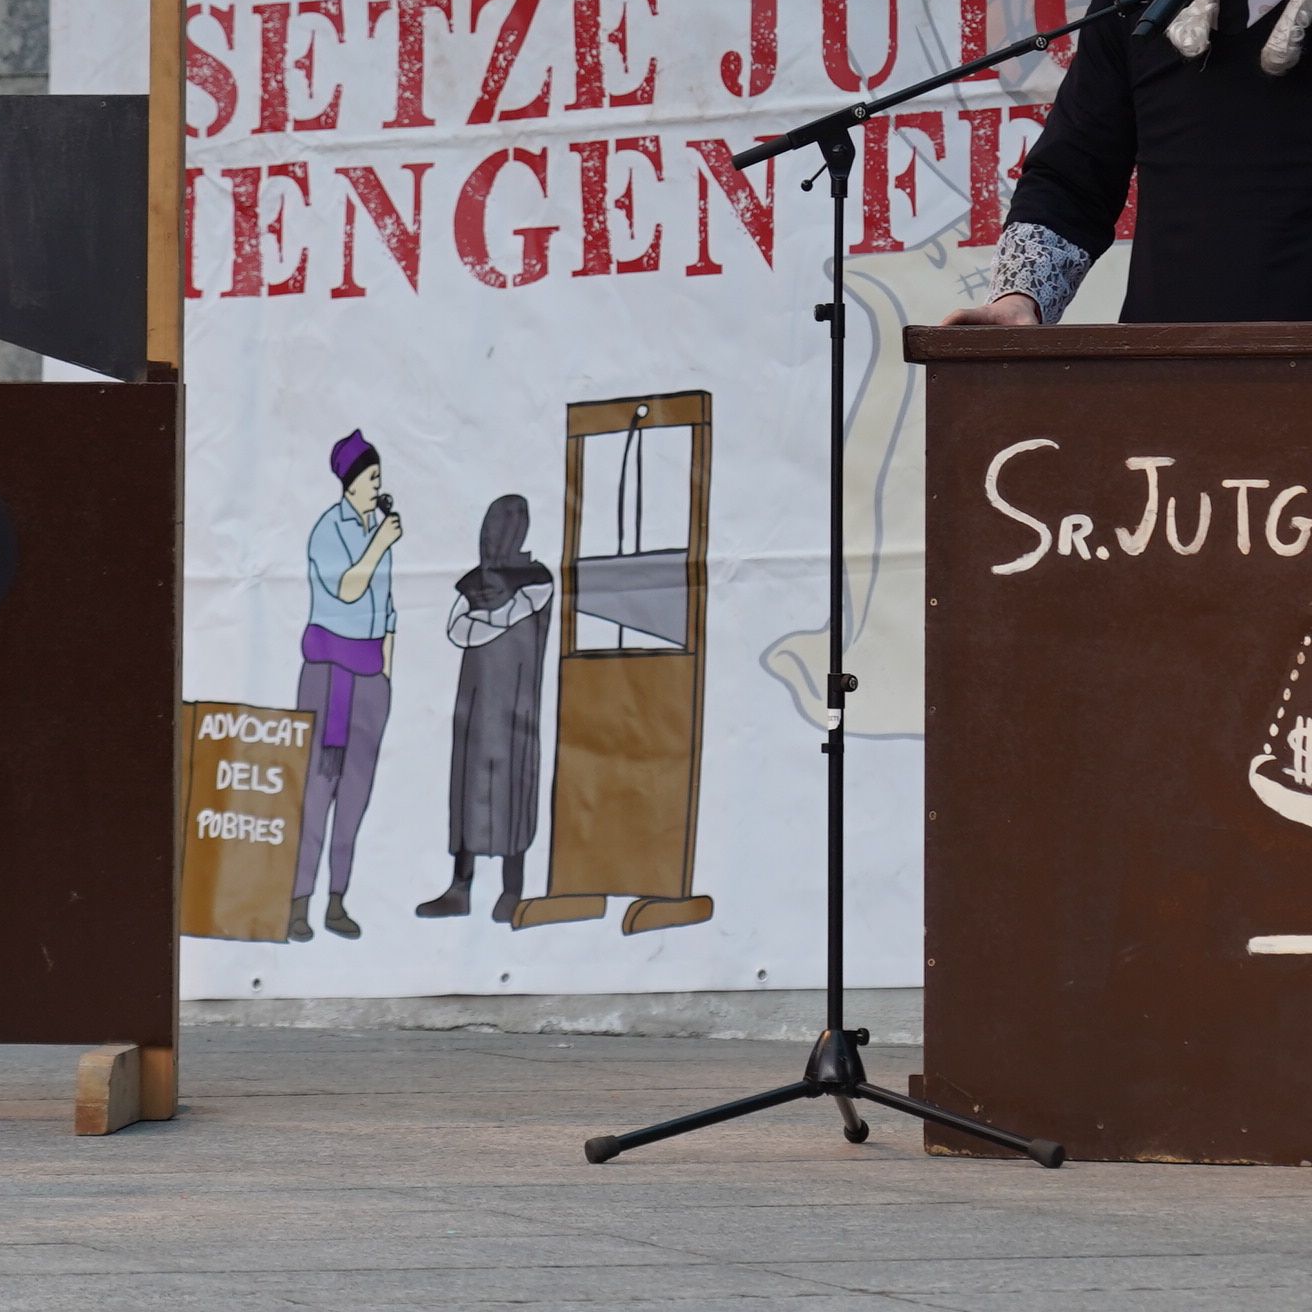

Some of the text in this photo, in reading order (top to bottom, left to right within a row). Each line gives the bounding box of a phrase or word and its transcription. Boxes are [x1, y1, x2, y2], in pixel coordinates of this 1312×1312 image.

[197, 712, 310, 748] ADVOCAT
[215, 759, 284, 794] DELS
[196, 807, 286, 846] POBRES
